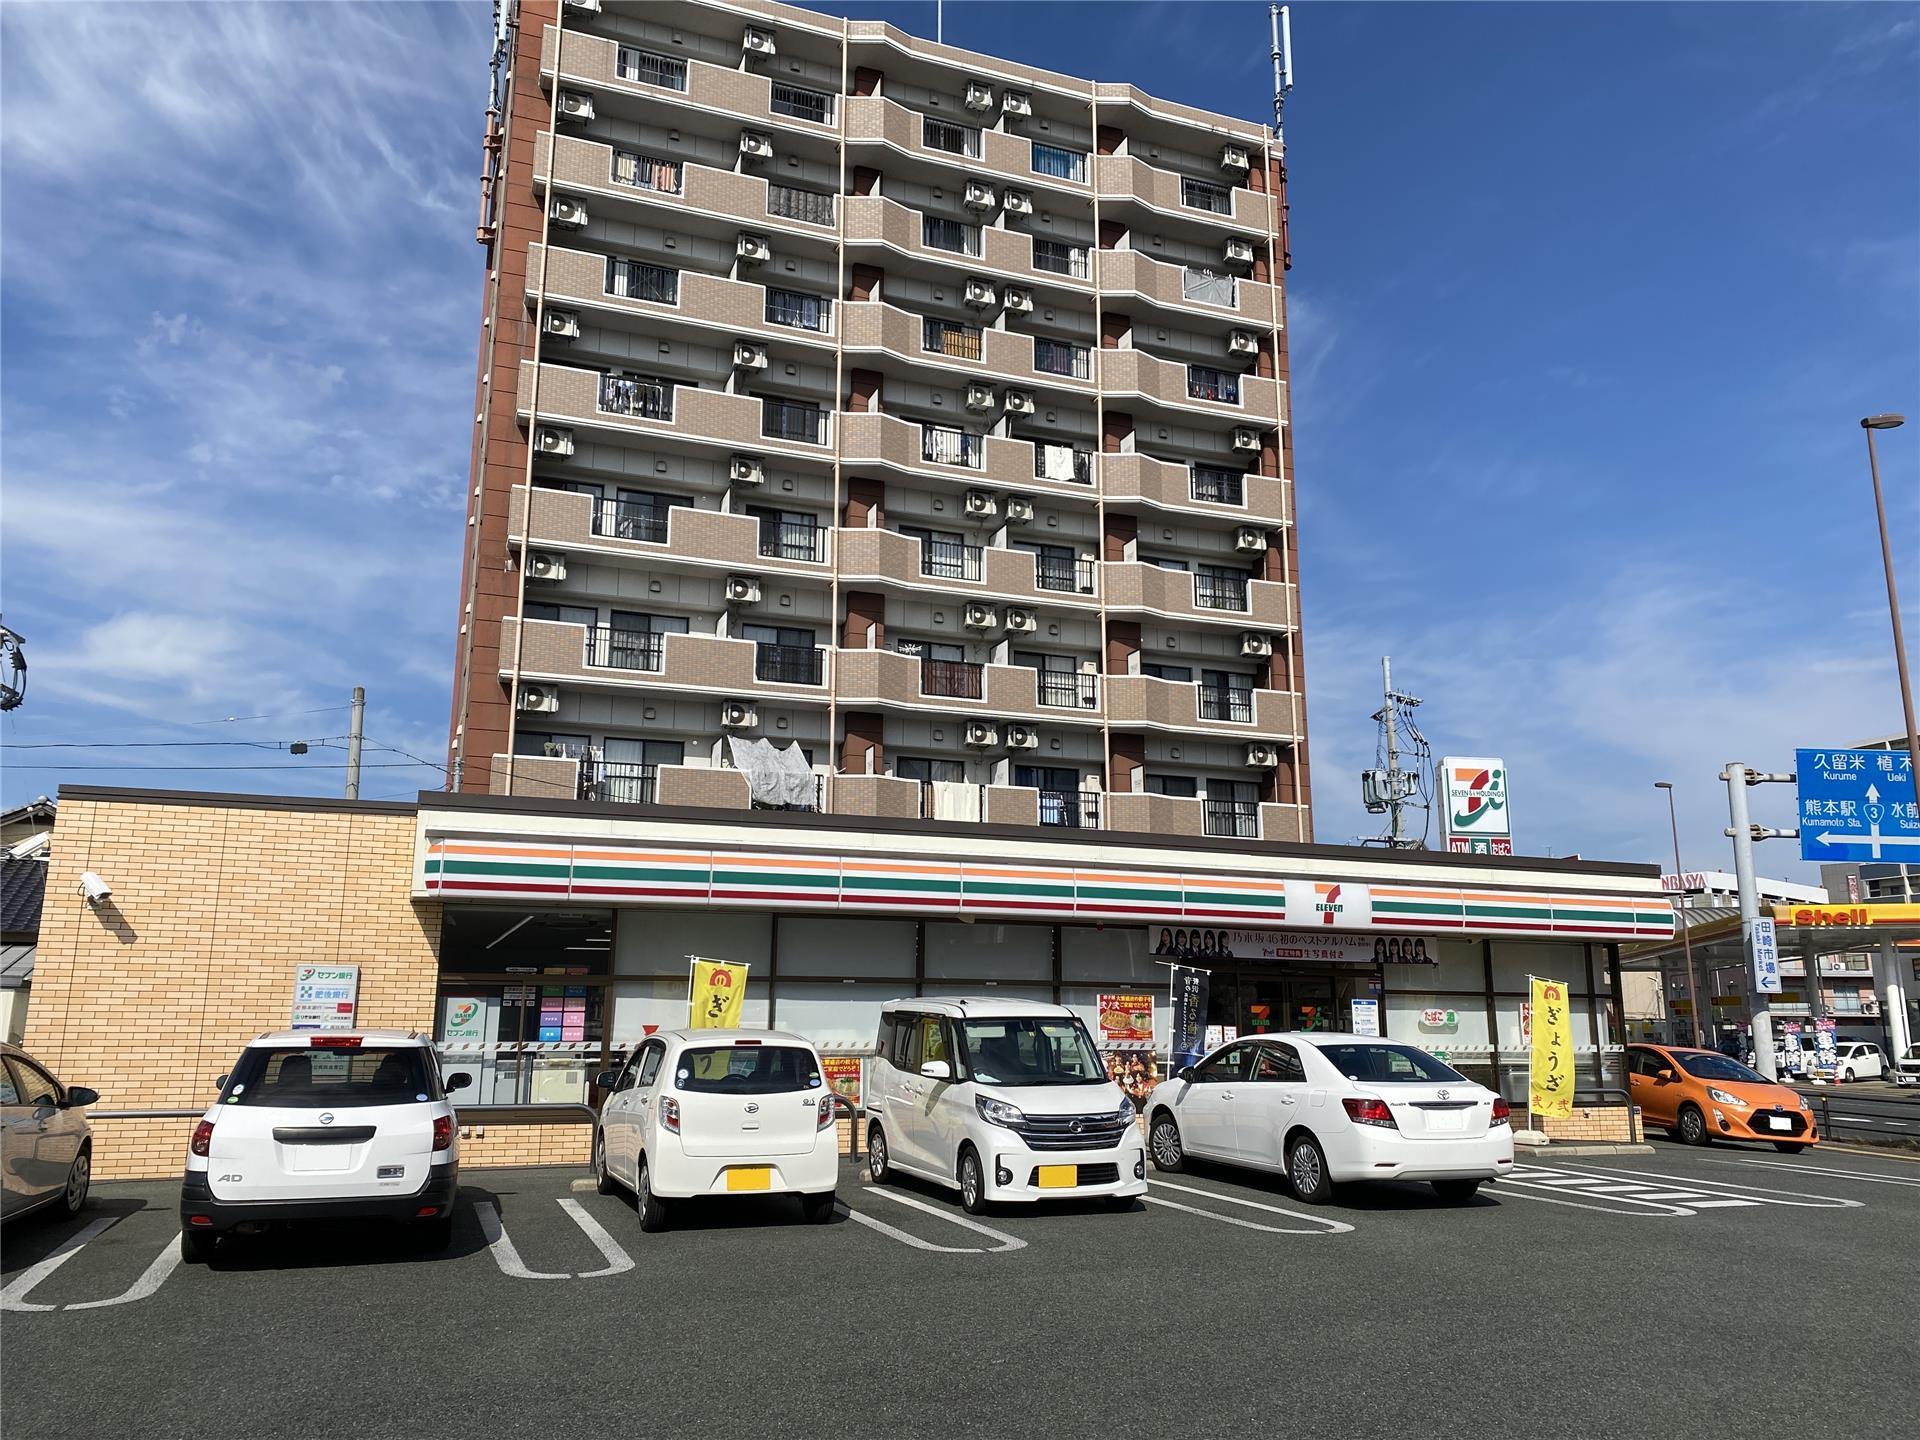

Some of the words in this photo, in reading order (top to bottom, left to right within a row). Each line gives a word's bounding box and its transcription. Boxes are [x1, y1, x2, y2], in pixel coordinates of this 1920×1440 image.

[1813, 753, 1866, 771] 久留米
[1823, 770, 1857, 781] Kurume
[1887, 773, 1907, 782] Ueki
[1804, 799, 1857, 817] 熊本駅
[1869, 807, 1879, 819] 3
[1802, 816, 1845, 827] Kumamoto
[1847, 818, 1863, 828] Sta.
[1451, 841, 1470, 853] ATM
[1474, 842, 1487, 855] 酒
[1492, 842, 1511, 856] たばこ
[1795, 908, 1868, 926] Shell
[1761, 922, 1776, 974] 田崎市場
[317, 971, 353, 980] セブン銀行
[1424, 1011, 1444, 1022] たばこ
[446, 1029, 478, 1037] セブン銀行
[1545, 1005, 1565, 1092] ぎょうざ
[217, 1173, 243, 1183] AD
